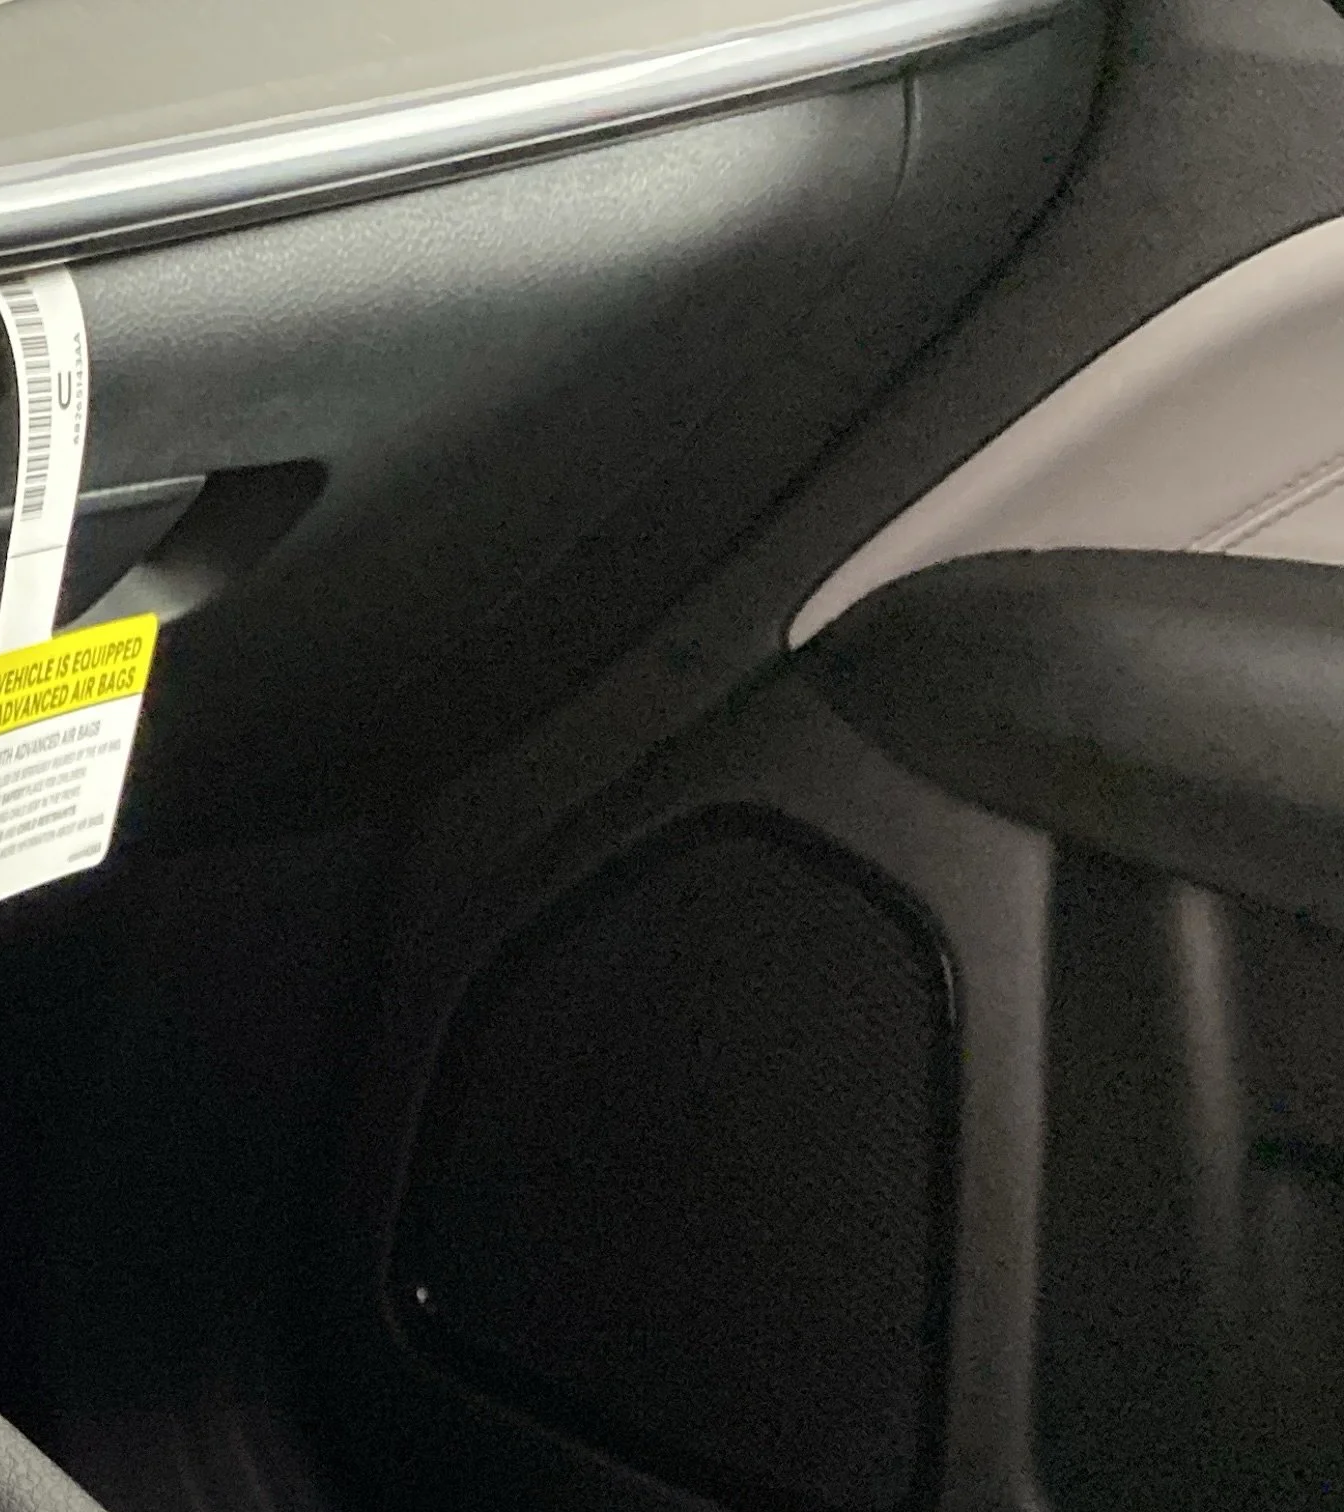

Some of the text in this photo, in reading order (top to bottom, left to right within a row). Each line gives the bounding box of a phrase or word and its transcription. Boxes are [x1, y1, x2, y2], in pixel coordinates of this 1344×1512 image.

[55, 657, 69, 679] IS
[72, 636, 143, 672] EQUIPPED
[70, 676, 96, 702] AIR
[97, 665, 137, 697] BAGS
[15, 732, 61, 763] ADVANCED
[61, 726, 77, 744] AIR
[77, 720, 101, 742] BAGS
